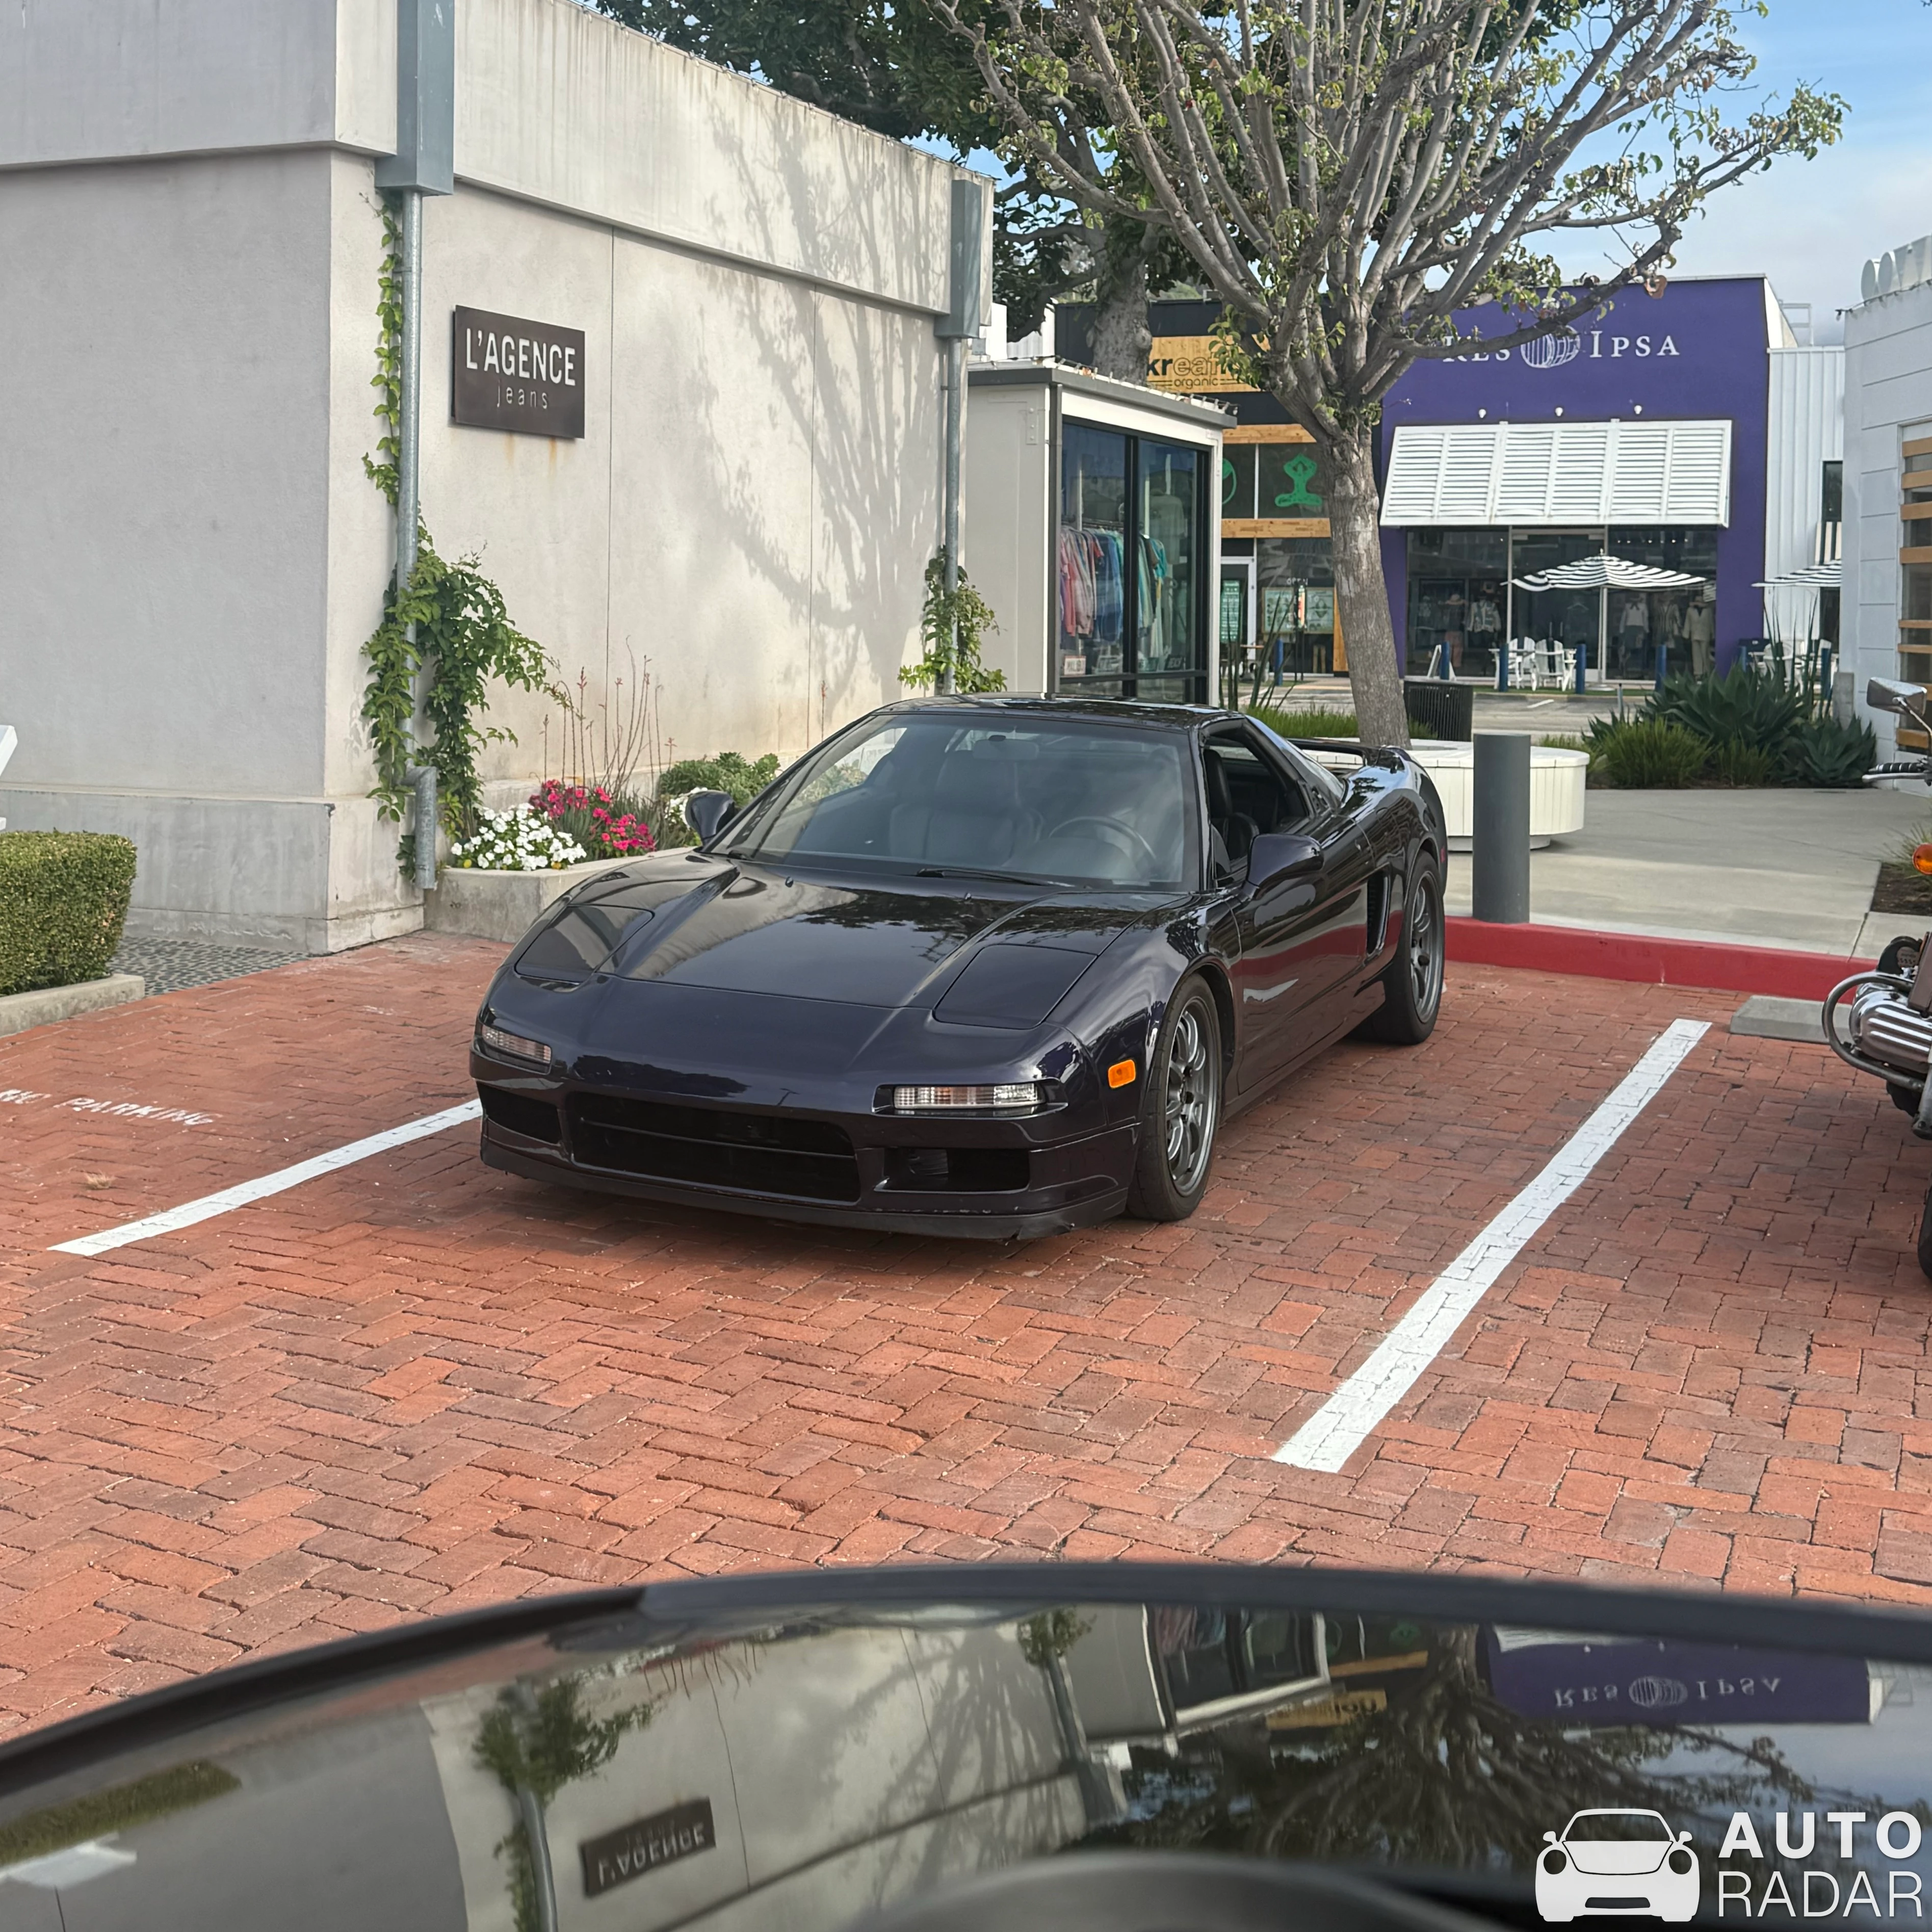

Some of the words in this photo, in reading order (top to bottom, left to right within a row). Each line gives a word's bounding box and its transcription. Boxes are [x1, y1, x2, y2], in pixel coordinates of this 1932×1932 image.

[466, 328, 576, 386] L'AGENCE
[1589, 330, 1680, 358] IPSA
[497, 379, 549, 409] jeans
[1173, 376, 1219, 389] organic
[53, 1098, 223, 1125] PARKING
